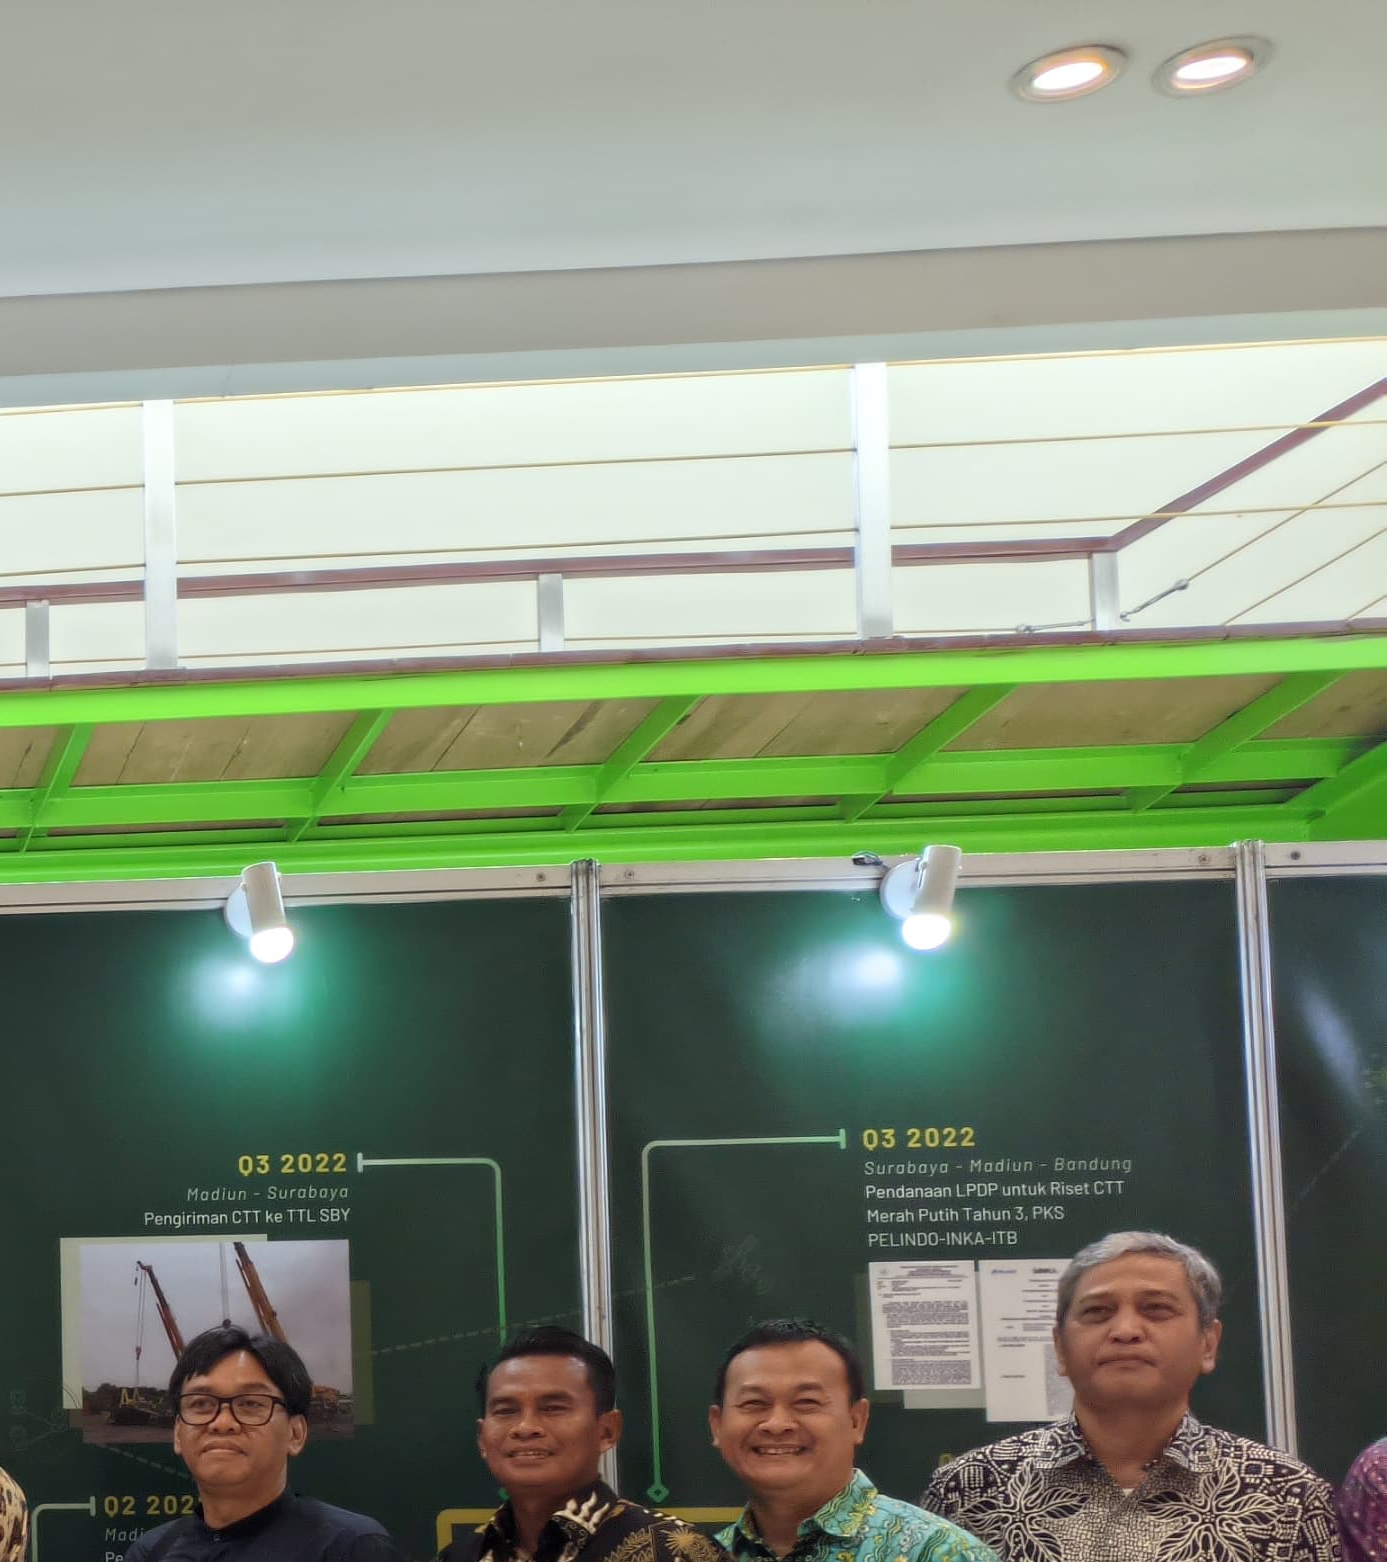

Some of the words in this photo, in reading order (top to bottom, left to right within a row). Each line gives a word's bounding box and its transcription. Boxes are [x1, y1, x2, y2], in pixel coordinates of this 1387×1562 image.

[862, 1128, 896, 1151] Q3
[907, 1127, 975, 1148] 2022
[238, 1155, 270, 1176] Q3
[280, 1153, 347, 1174] 2022
[864, 1161, 948, 1176] Surabaya
[970, 1159, 1032, 1173] Madiun
[1054, 1157, 1132, 1173] Bandung
[186, 1187, 247, 1201] Madiun
[267, 1186, 349, 1201] Surabaya
[865, 1185, 951, 1199] Pendanaan
[956, 1183, 998, 1198] LPDP
[1002, 1181, 1046, 1196] untuk
[1050, 1182, 1090, 1195] Riset
[1093, 1180, 1125, 1195] CTT
[144, 1212, 228, 1229] Pengiriman
[232, 1210, 261, 1224] CTT
[265, 1210, 283, 1223] ke
[287, 1209, 316, 1223] TTL
[319, 1208, 351, 1222] SBY
[867, 1209, 915, 1223] Merah
[919, 1208, 959, 1222] Putih
[962, 1207, 1011, 1221] Tahun
[1015, 1207, 1028, 1222] 3,
[1032, 1206, 1065, 1220] PKS
[868, 1231, 1018, 1247] PELINDO-INKA-ITB
[104, 1495, 135, 1518] Q2
[146, 1494, 193, 1516] 202
[105, 1527, 143, 1542] Madi
